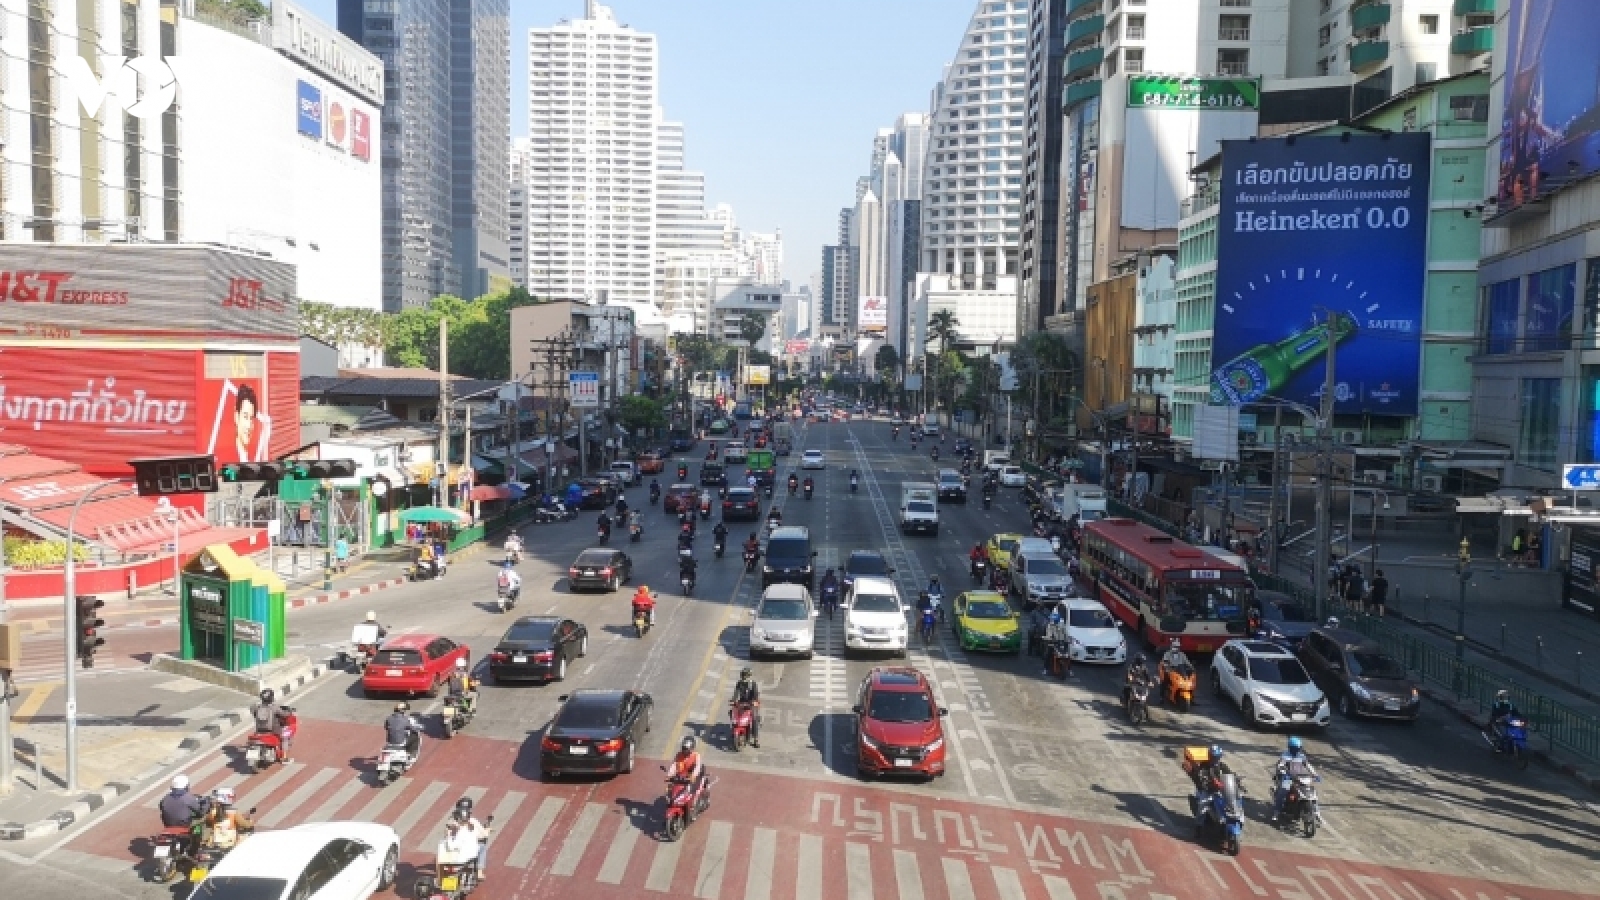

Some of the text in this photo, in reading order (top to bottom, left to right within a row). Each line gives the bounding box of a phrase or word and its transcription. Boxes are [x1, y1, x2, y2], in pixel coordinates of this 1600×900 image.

[1235, 156, 1413, 186] เลือกขับปลอดภัย
[1366, 206, 1411, 230] 0.0
[61, 290, 129, 305] EXPRESS
[222, 277, 263, 311] J&T
